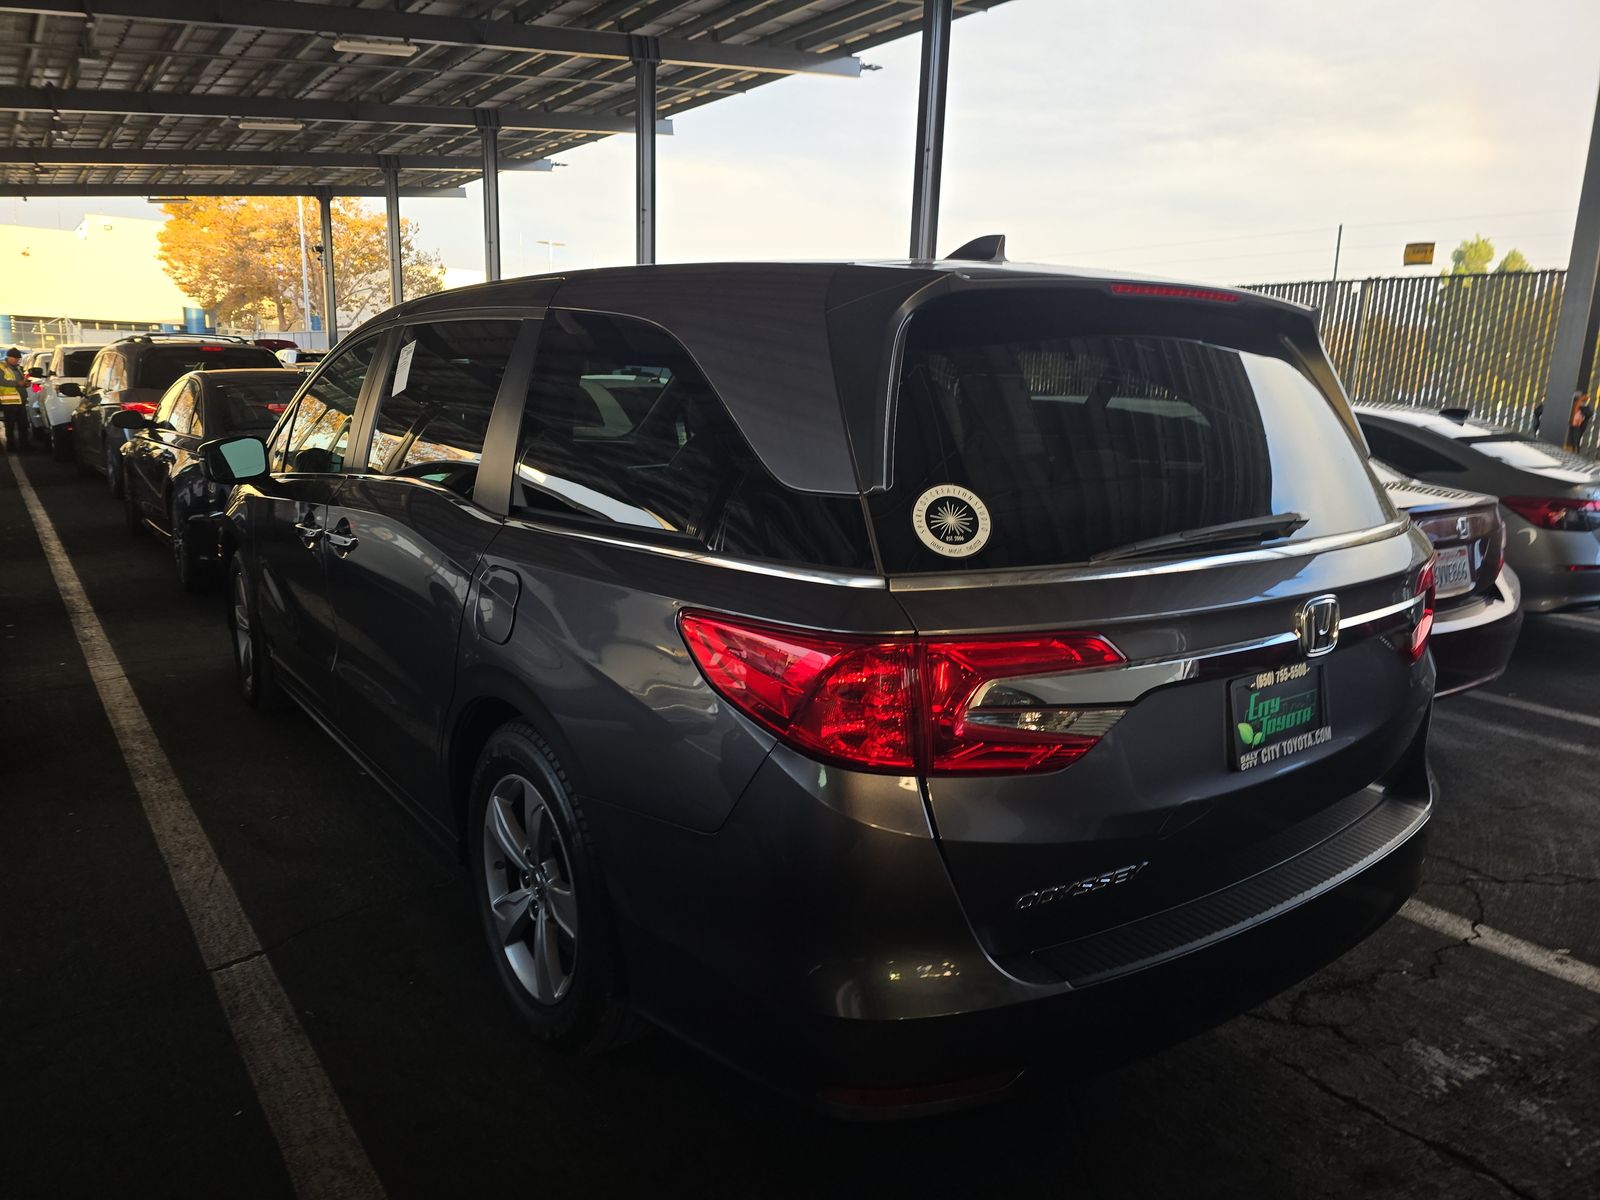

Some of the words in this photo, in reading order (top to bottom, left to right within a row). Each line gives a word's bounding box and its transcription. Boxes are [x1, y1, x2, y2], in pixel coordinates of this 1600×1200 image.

[930, 487, 974, 502] CREATION
[1240, 748, 1260, 764] DALY
[1240, 758, 1258, 771] CITY
[1015, 861, 1149, 910] ODYSSEY
